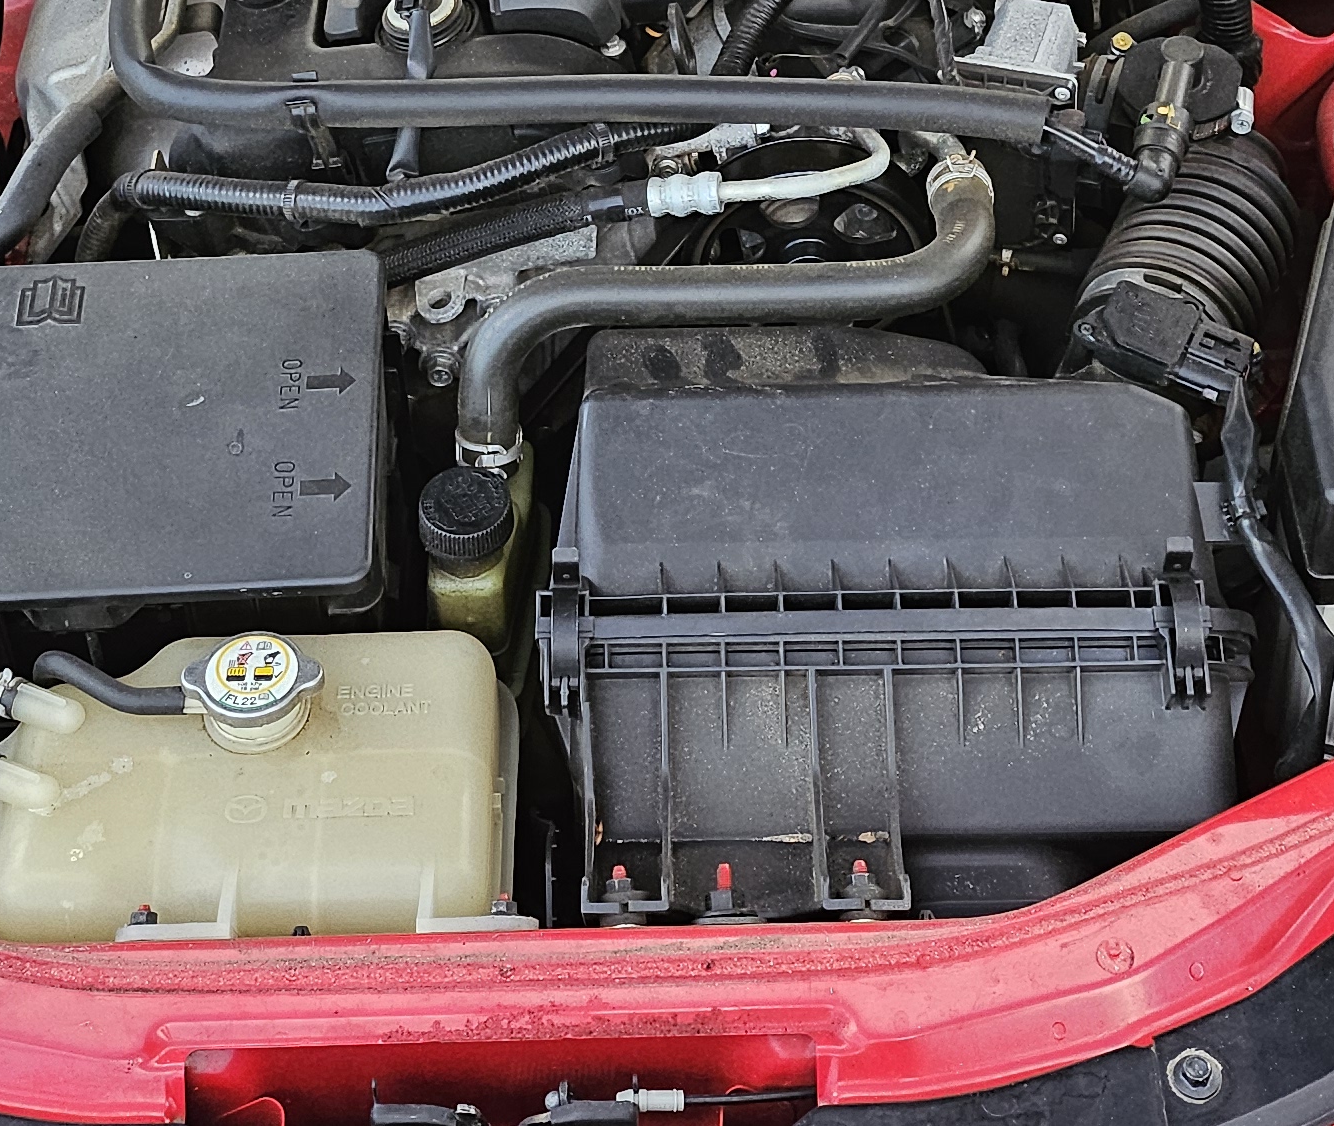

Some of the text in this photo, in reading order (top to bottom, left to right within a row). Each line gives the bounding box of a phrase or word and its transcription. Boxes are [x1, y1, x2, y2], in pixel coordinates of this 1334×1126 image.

[278, 358, 303, 410] OPEN
[271, 461, 296, 517] OPEN
[336, 683, 415, 699] ENGINE
[224, 693, 258, 706] FL22
[340, 700, 432, 716] COOLANT
